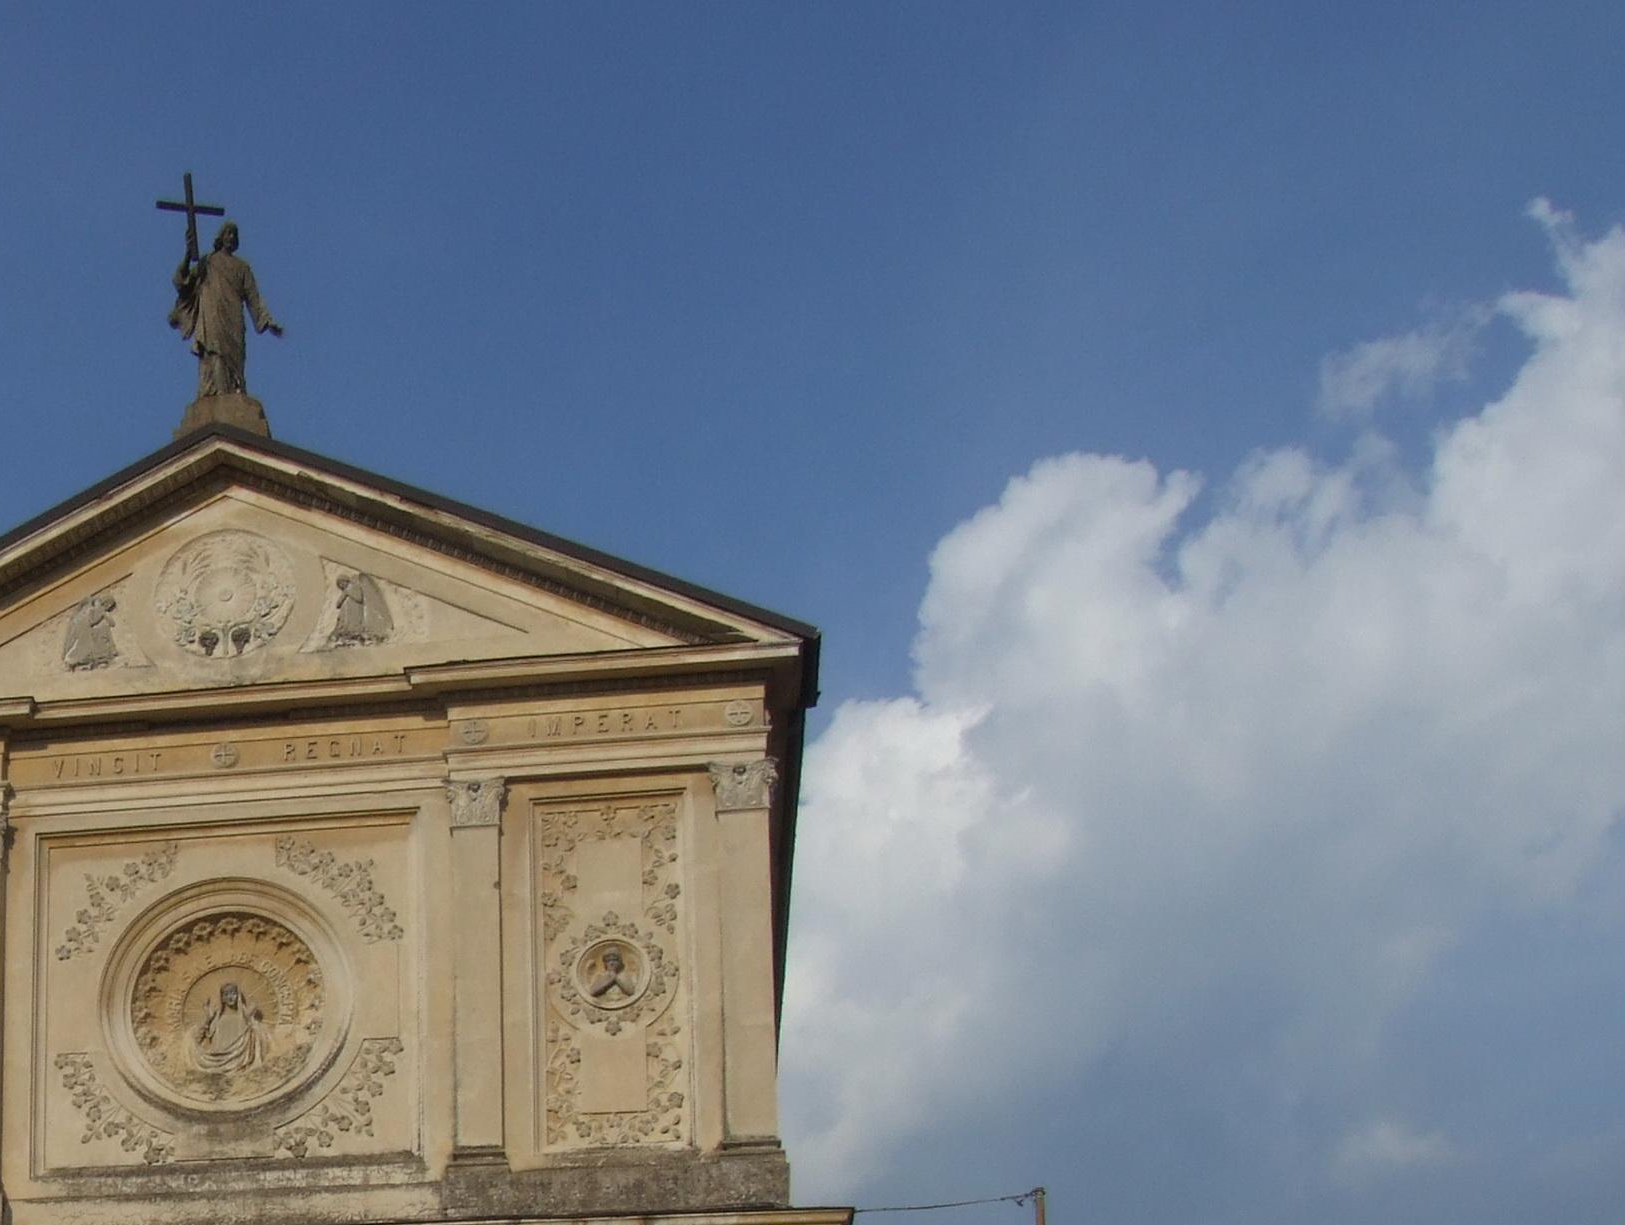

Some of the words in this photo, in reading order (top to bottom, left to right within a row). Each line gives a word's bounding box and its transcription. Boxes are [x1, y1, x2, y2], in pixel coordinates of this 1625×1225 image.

[54, 752, 163, 779] VINCIT
[283, 735, 408, 761] REGNAT
[526, 709, 682, 738] IMPERAT
